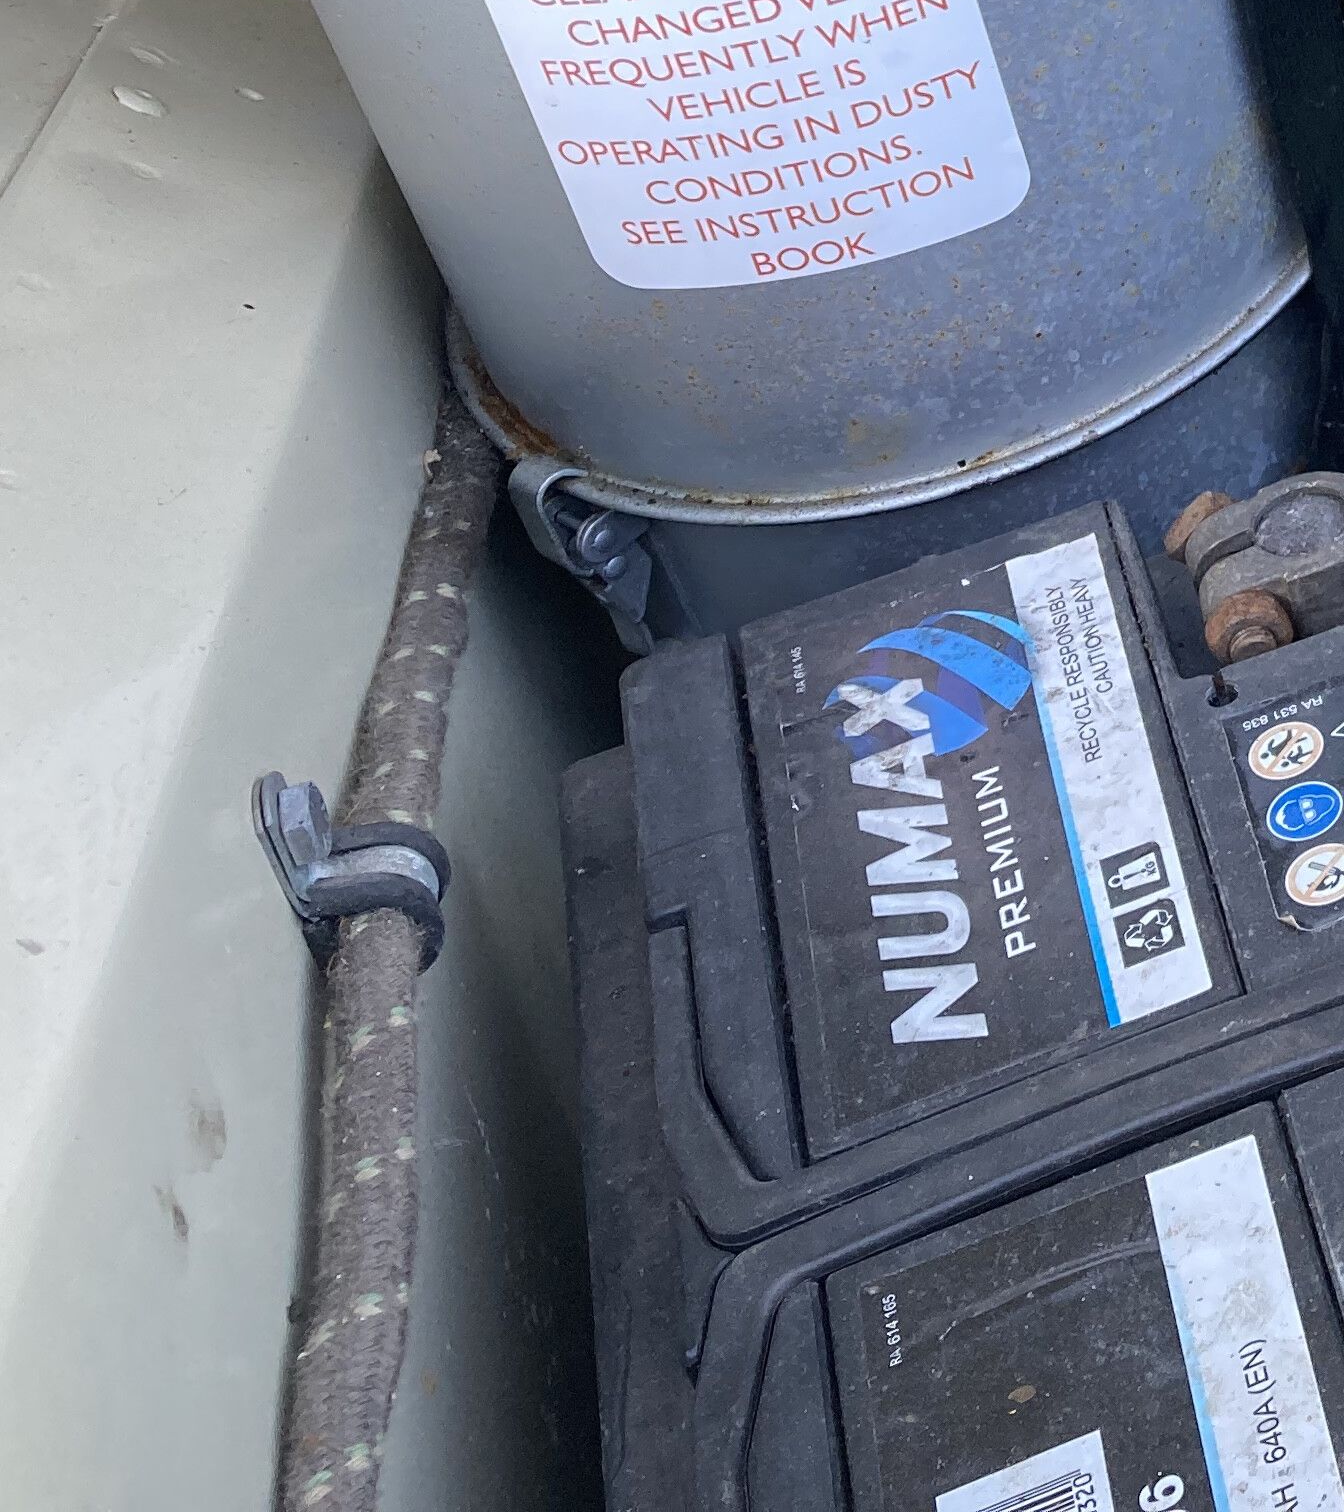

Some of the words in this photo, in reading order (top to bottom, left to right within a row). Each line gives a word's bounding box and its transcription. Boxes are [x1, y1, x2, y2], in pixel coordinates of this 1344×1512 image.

[539, 29, 806, 89] FREQUENTLY
[557, 123, 784, 167] OPERATING
[795, 110, 841, 144] IN
[850, 60, 981, 130] DUSTY
[646, 77, 823, 123] VEHICLE
[836, 59, 867, 89] IS
[644, 134, 923, 206] CONDITIONS.
[620, 219, 687, 245] SEE
[697, 156, 975, 243] INSTRUCTION
[750, 231, 875, 277] BOOK
[1069, 578, 1097, 626] HEAVY
[1045, 586, 1084, 687] RESPONSIBLY
[1084, 624, 1114, 694] CAUTION
[795, 679, 806, 694] RA
[1300, 694, 1323, 710] RA
[1070, 687, 1103, 763] RECYCLE
[837, 677, 988, 1044] NUMAX
[972, 766, 1036, 958] PREMIUM
[881, 1293, 897, 1319] 165
[885, 1320, 901, 1346] 614
[889, 1347, 903, 1367] RA
[1238, 1339, 1277, 1394] (EN)
[1253, 1396, 1287, 1464] 640A
[1073, 1473, 1097, 1512] 320
[1139, 1474, 1188, 1512] 6
